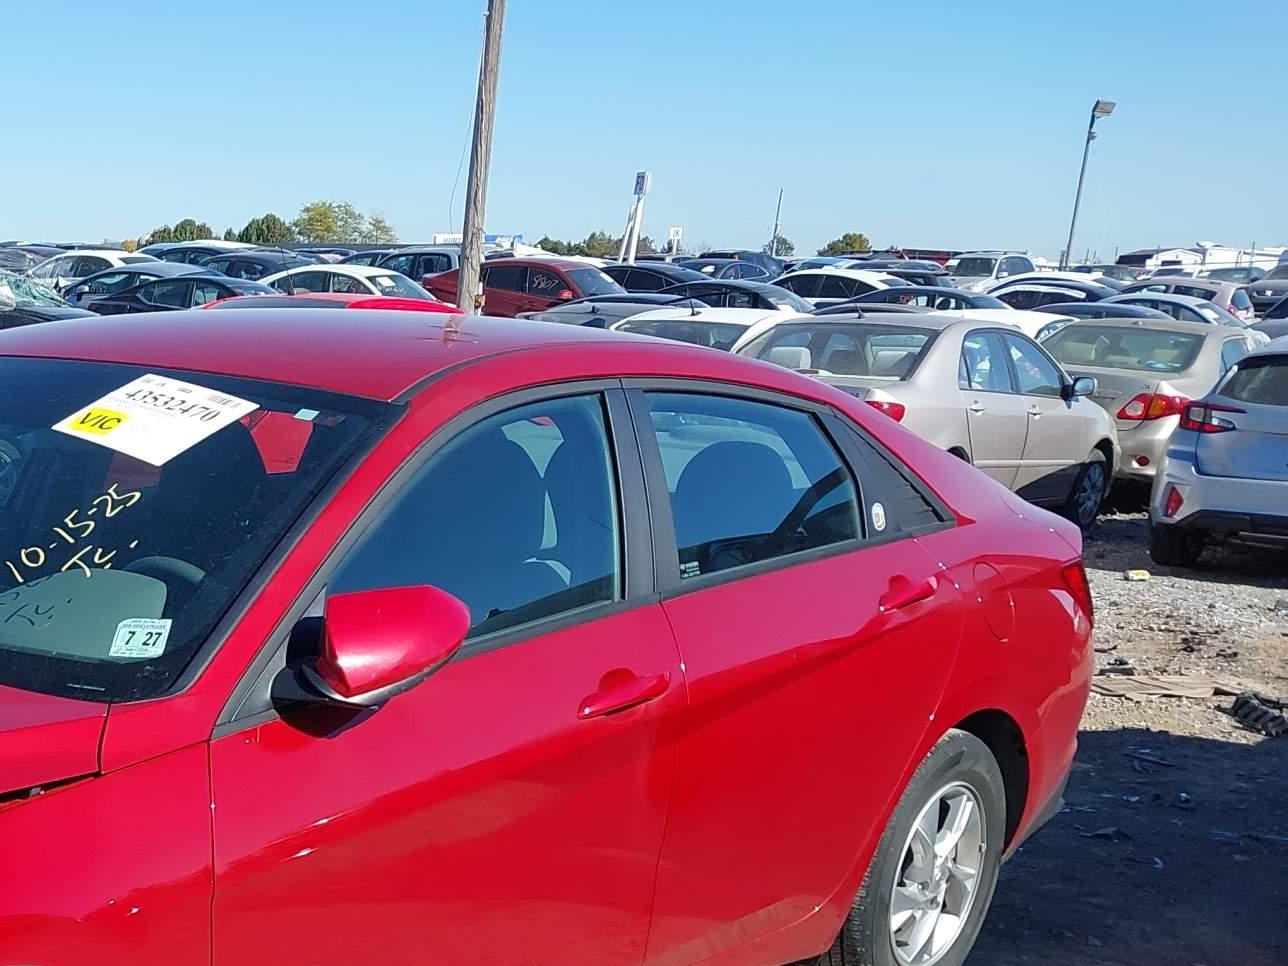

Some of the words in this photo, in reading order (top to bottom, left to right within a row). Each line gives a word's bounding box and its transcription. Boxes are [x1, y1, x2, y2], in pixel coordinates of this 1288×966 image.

[125, 388, 221, 422] 43532470
[79, 411, 122, 430] VIC
[5, 483, 142, 583] 10-15-25
[124, 630, 137, 646] 7
[142, 631, 163, 647] 27
